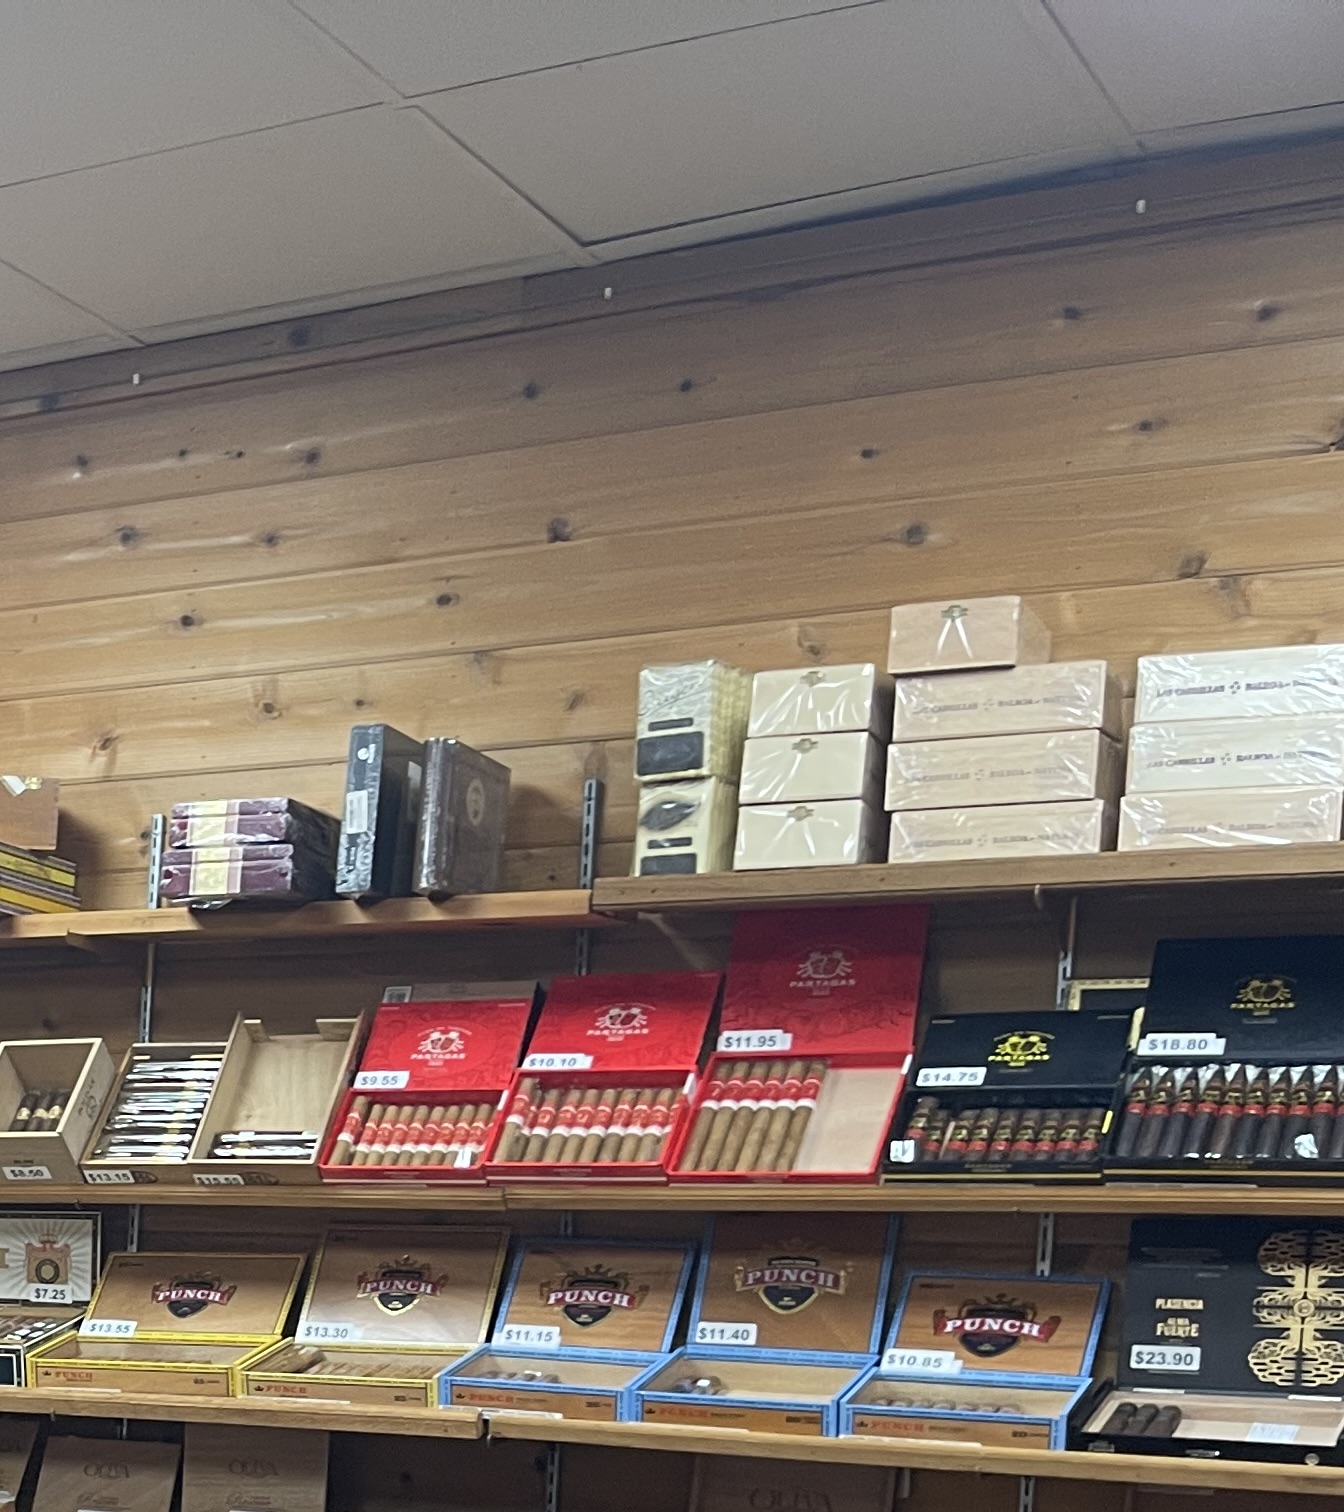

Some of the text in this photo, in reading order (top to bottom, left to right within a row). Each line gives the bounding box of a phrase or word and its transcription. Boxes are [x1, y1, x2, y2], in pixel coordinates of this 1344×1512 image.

[724, 1034, 777, 1048] $11.95
[1148, 1038, 1208, 1051] $18.80
[529, 1057, 577, 1067] $10.10
[361, 1075, 398, 1086] $9.55
[921, 1071, 978, 1083] $14.75
[746, 1269, 837, 1288] PUNCH
[34, 1287, 66, 1300] $7.25
[364, 1281, 433, 1295] PUNCH
[154, 1289, 221, 1303] PUNCH
[547, 1289, 632, 1309] PUNCH
[305, 1325, 348, 1339] $13.30
[944, 1316, 1041, 1337] PUNCH
[505, 1330, 554, 1343] $11.15
[699, 1328, 750, 1341] $11.40
[887, 1354, 943, 1369] $10.85
[1135, 1351, 1194, 1366] $23.90
